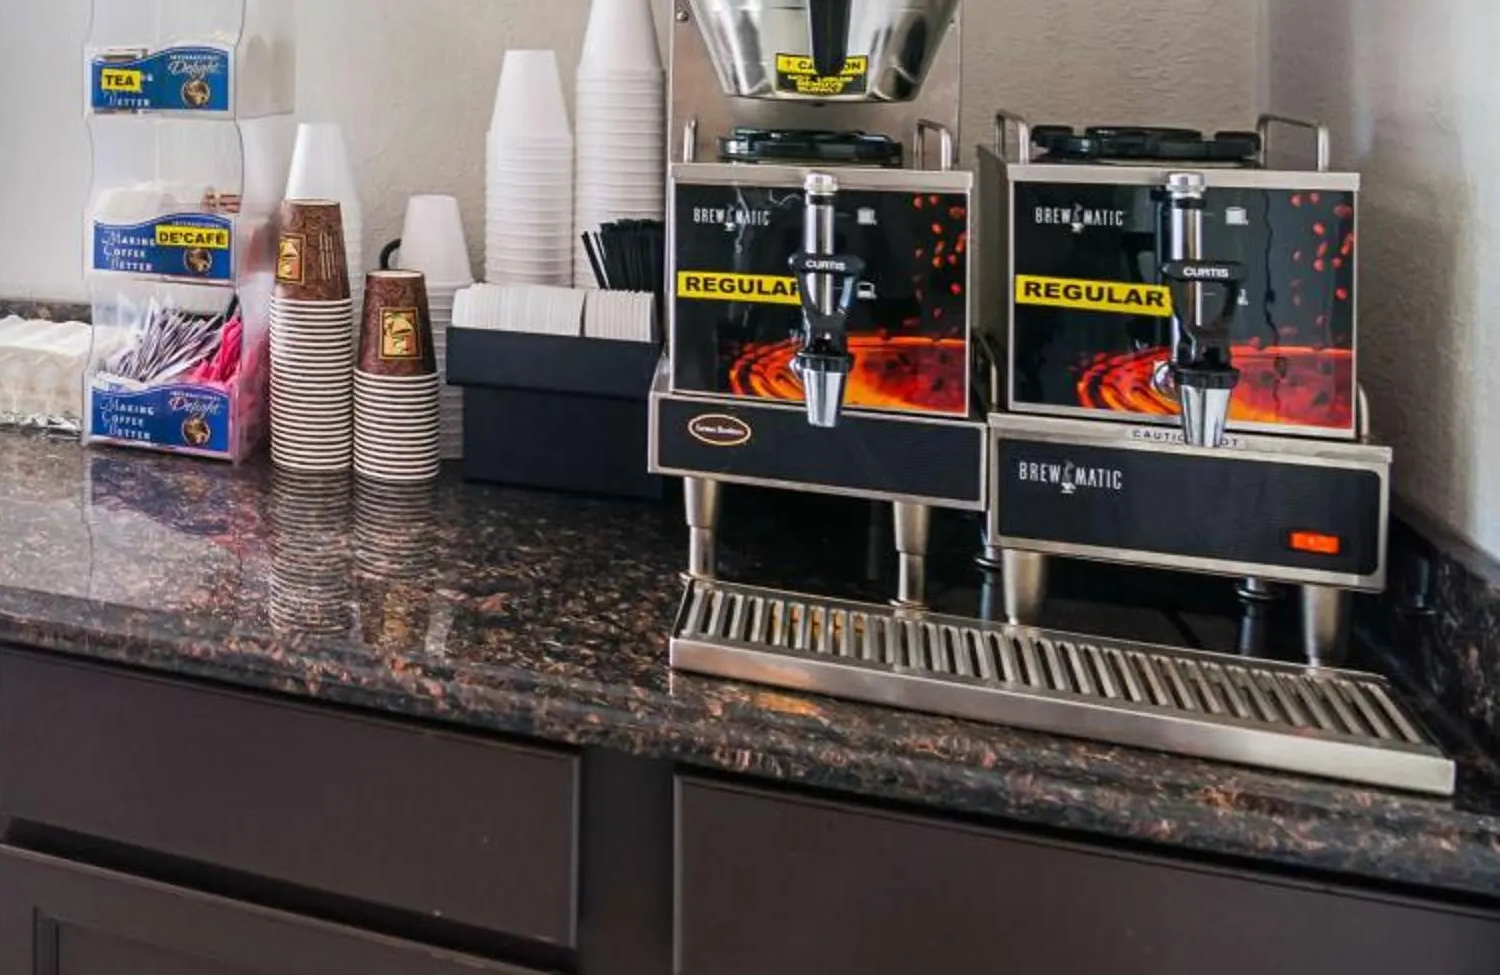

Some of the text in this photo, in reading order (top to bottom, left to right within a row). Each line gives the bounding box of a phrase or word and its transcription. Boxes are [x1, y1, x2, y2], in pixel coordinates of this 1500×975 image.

[105, 74, 135, 86] TEA
[102, 231, 155, 247] MAKING
[103, 246, 146, 258] COFFEE
[106, 256, 153, 271] BETTER
[805, 259, 846, 272] CURTIS
[1183, 266, 1229, 278] CURTIS
[1024, 281, 1164, 307] REGULAR
[100, 396, 155, 415] MAKING
[102, 412, 143, 427] COFFEE
[109, 424, 150, 439] BETTER
